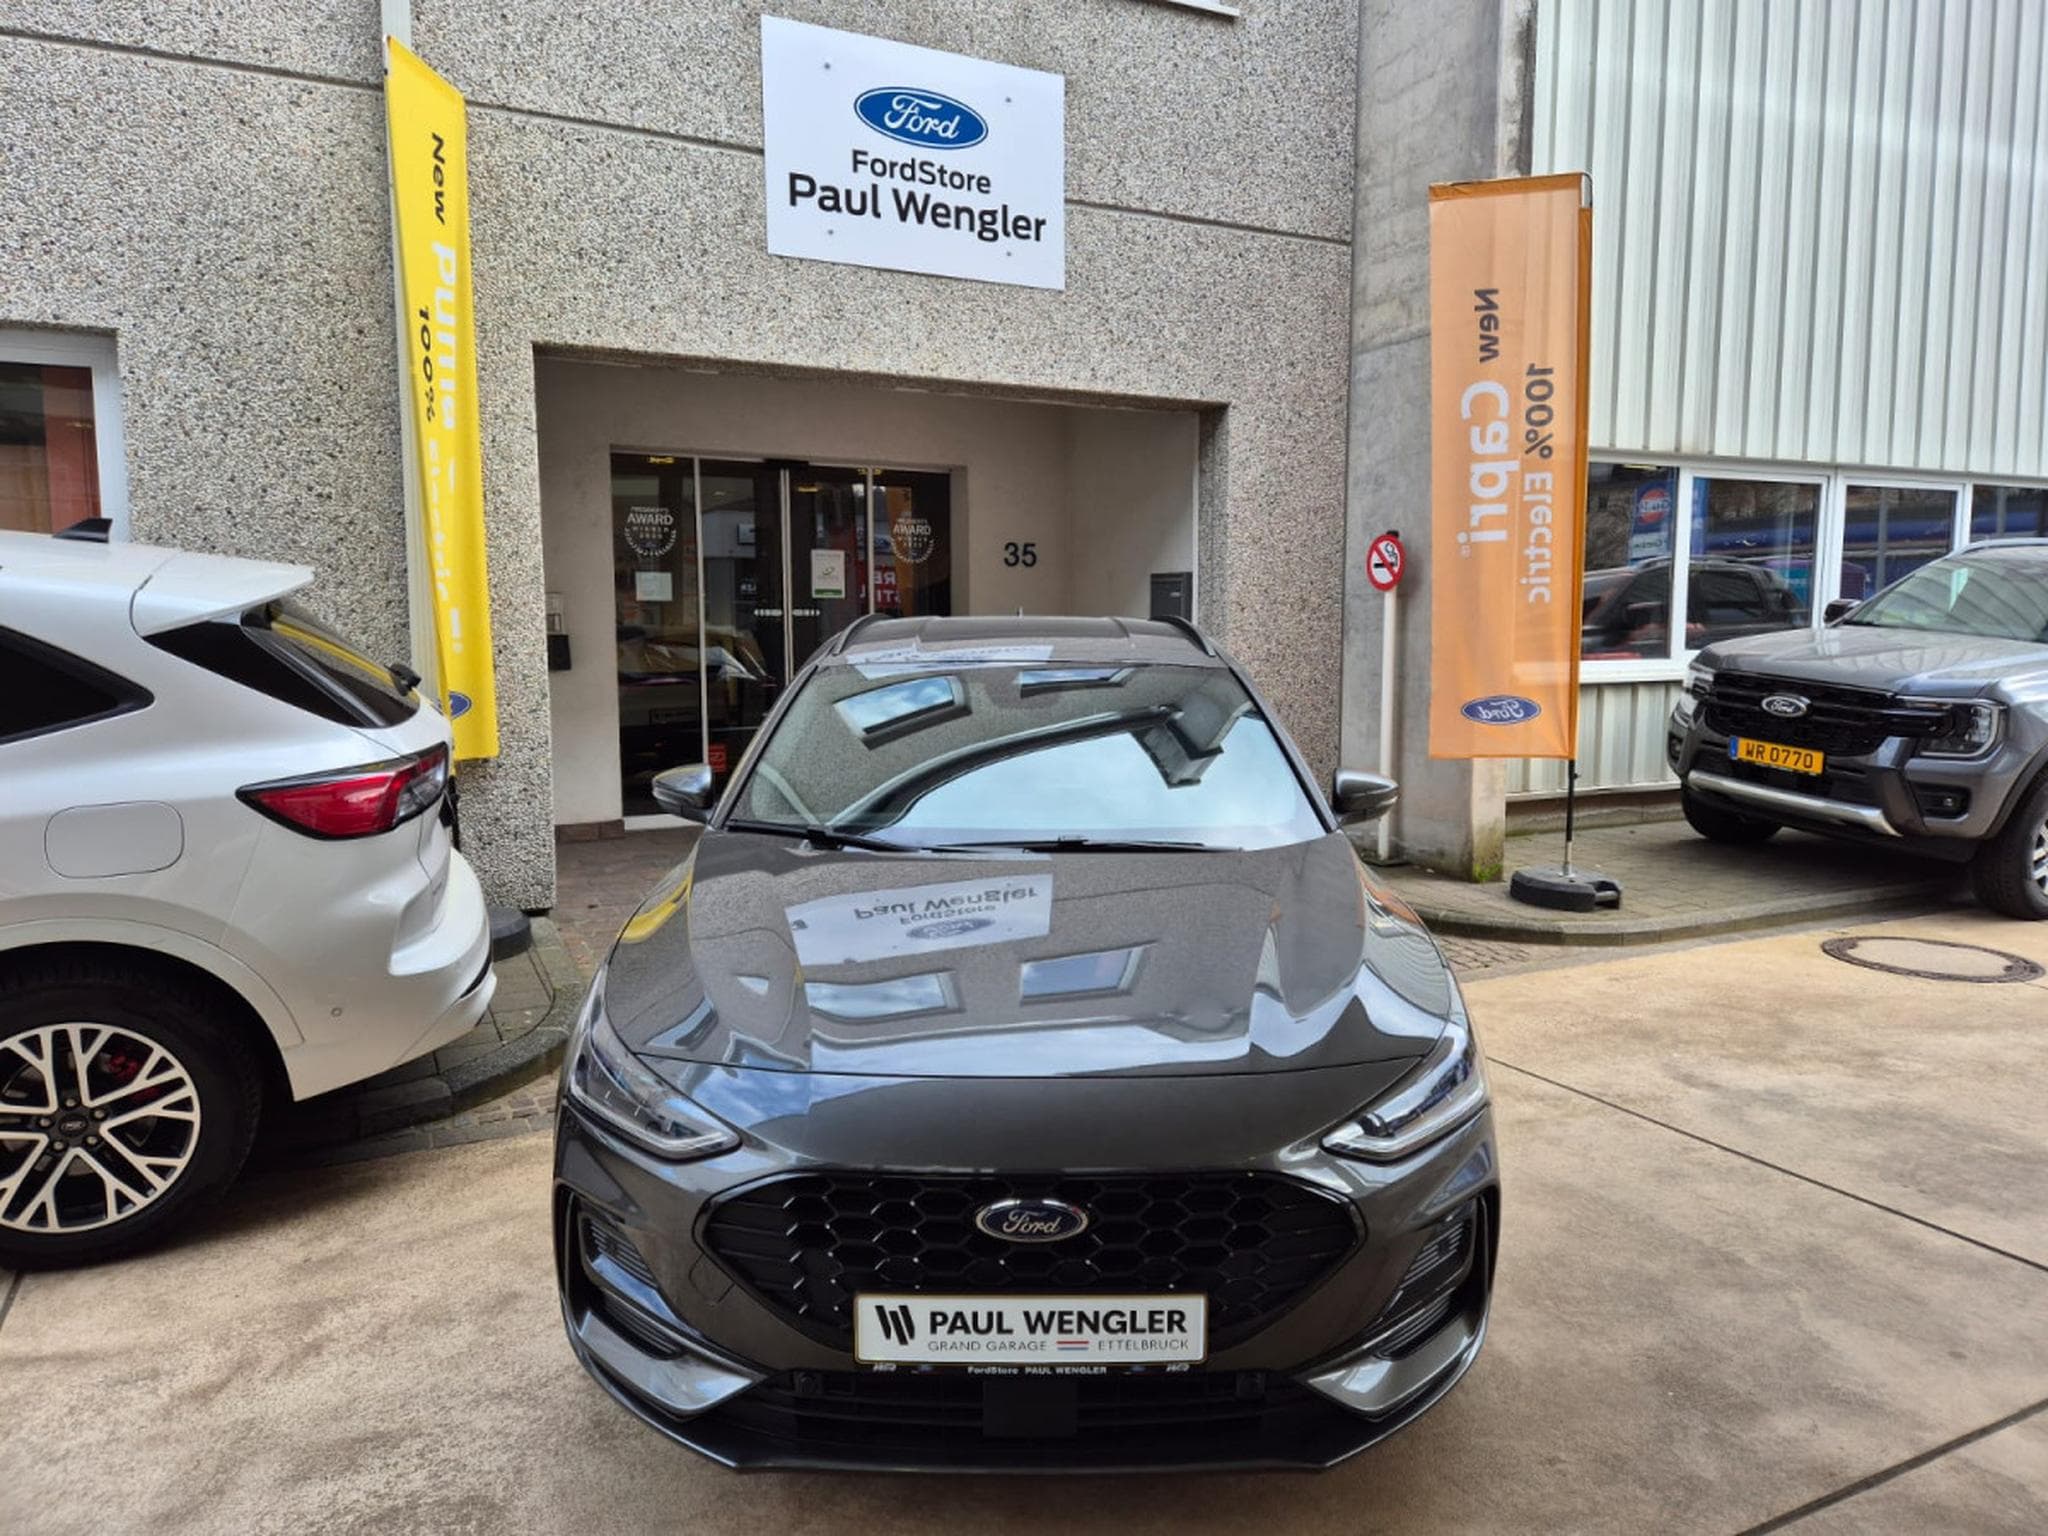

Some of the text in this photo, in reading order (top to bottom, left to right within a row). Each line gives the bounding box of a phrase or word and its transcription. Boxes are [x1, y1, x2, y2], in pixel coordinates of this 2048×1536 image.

[431, 132, 446, 225] New
[852, 149, 991, 194] FordStore
[789, 172, 1046, 242] Paul Wengler
[418, 304, 437, 422] 100%
[627, 513, 674, 526] AWARD
[893, 524, 931, 536] AWARD
[1003, 542, 1037, 567] 35
[1745, 742, 1813, 768] WR 0770
[928, 1310, 1188, 1334] PAUL WENGLER
[928, 1339, 1189, 1352] GRAND GARAGE ETTELBRUCK
[967, 1366, 1107, 1375] FordStore PAUL WENGLER
